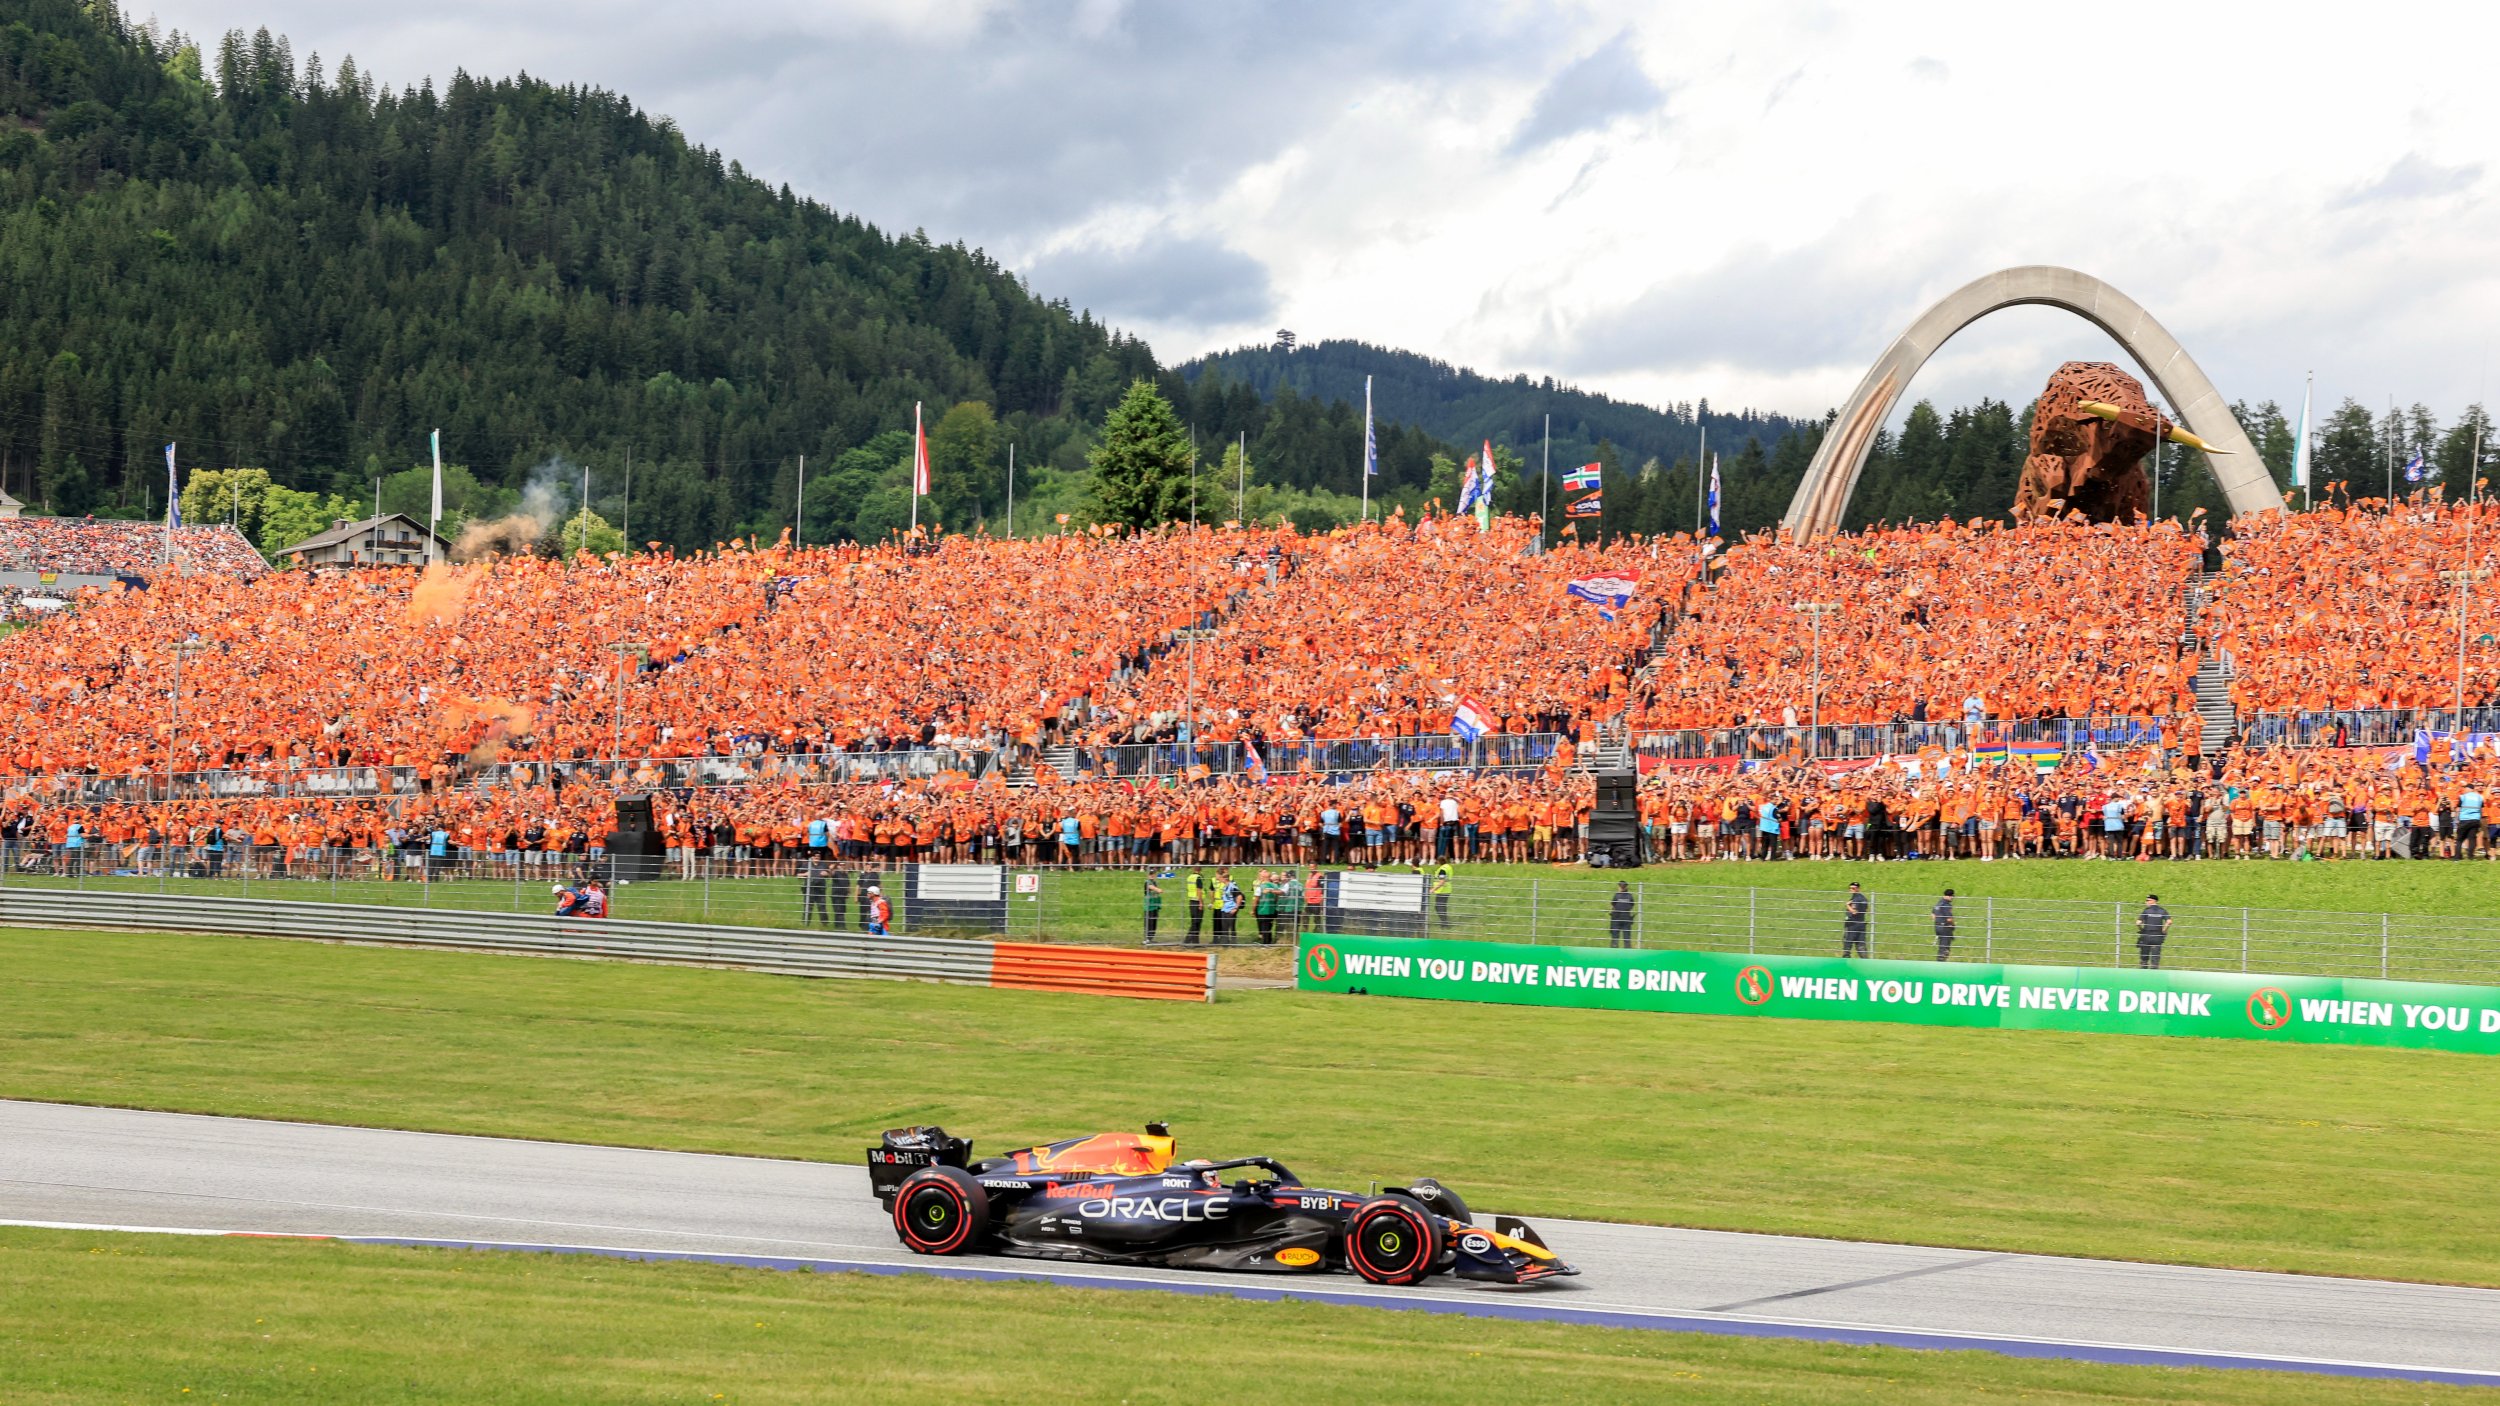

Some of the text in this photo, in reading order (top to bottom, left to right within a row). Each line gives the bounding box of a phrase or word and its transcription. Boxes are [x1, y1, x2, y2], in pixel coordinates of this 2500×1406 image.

[1344, 953, 1707, 994] WHEN YOU DRIVE NEVER DRINK
[1780, 975, 2212, 1017] WHEN YOU DRIVE NEVER DRINK
[2299, 998, 2394, 1027] WHEN
[2401, 1003, 2470, 1032] YOU
[871, 1150, 913, 1165] Mobil
[984, 1180, 1031, 1189] HONDA
[1162, 1178, 1192, 1189] ROKT
[1078, 1197, 1230, 1222] ORACLE
[1300, 1195, 1341, 1211] BYBIT
[1466, 1238, 1487, 1248] Esso
